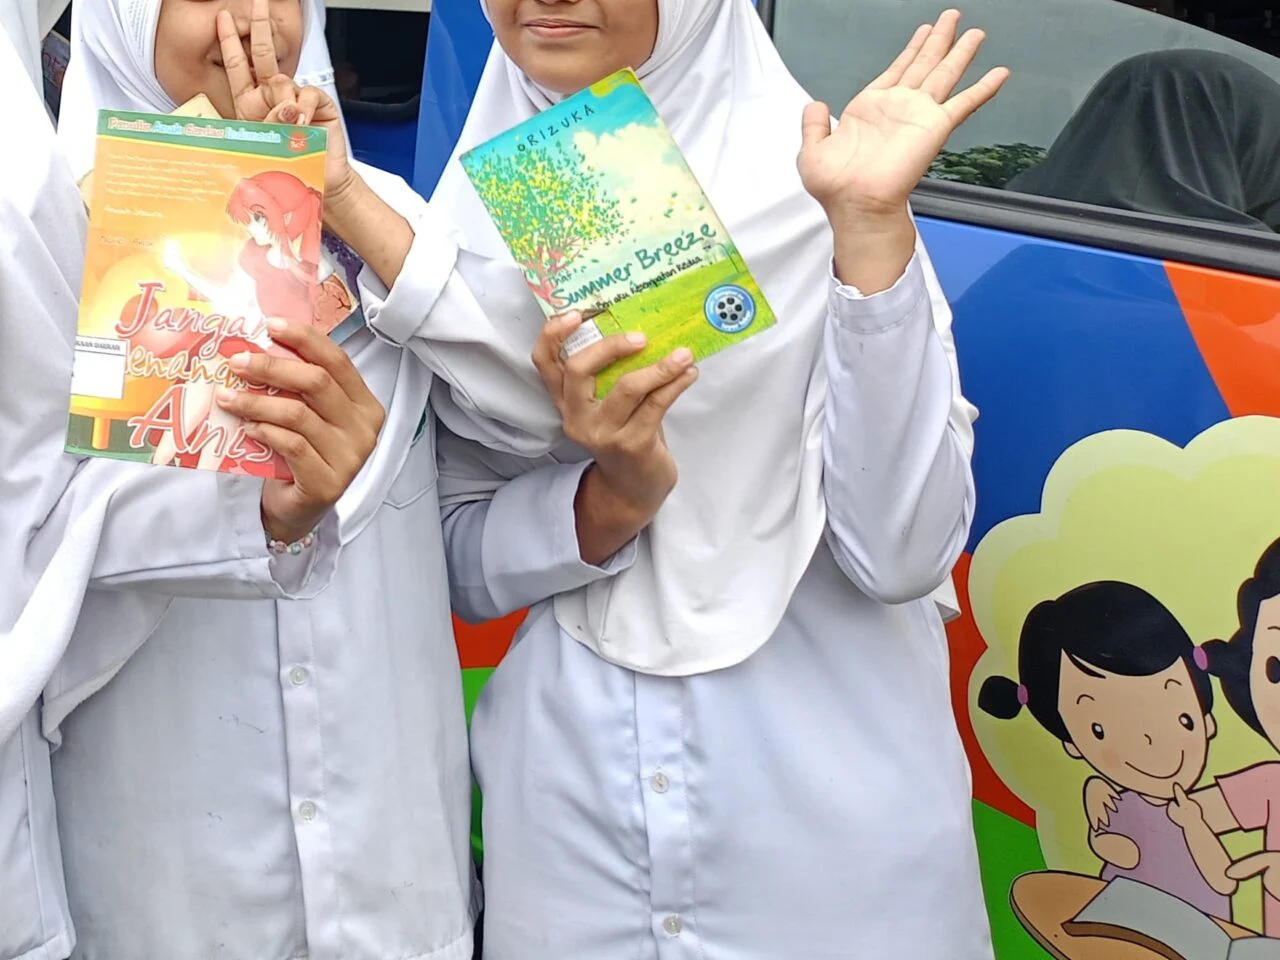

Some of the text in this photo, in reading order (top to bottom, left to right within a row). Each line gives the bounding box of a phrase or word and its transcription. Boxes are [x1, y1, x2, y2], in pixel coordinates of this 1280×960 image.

[517, 104, 595, 152] ORIZUKA
[551, 223, 717, 311] Summer Breeze
